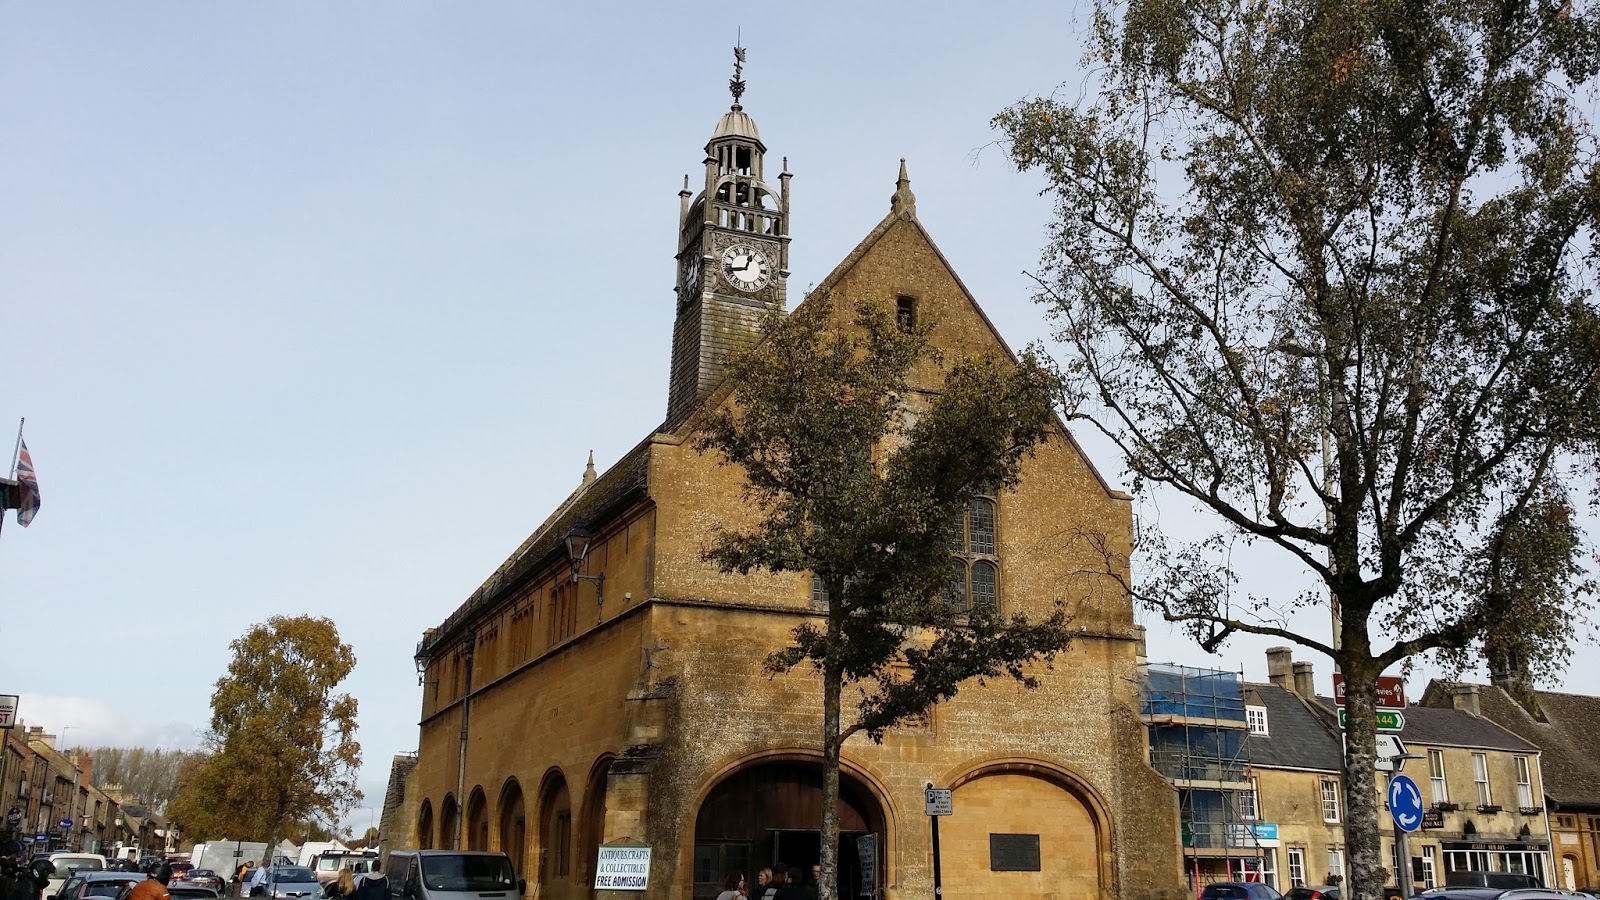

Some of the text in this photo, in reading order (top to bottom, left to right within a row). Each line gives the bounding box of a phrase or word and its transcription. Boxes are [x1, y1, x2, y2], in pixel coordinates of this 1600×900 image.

[1376, 688, 1393, 696] avies
[597, 875, 646, 887] FREE ADMISSION
